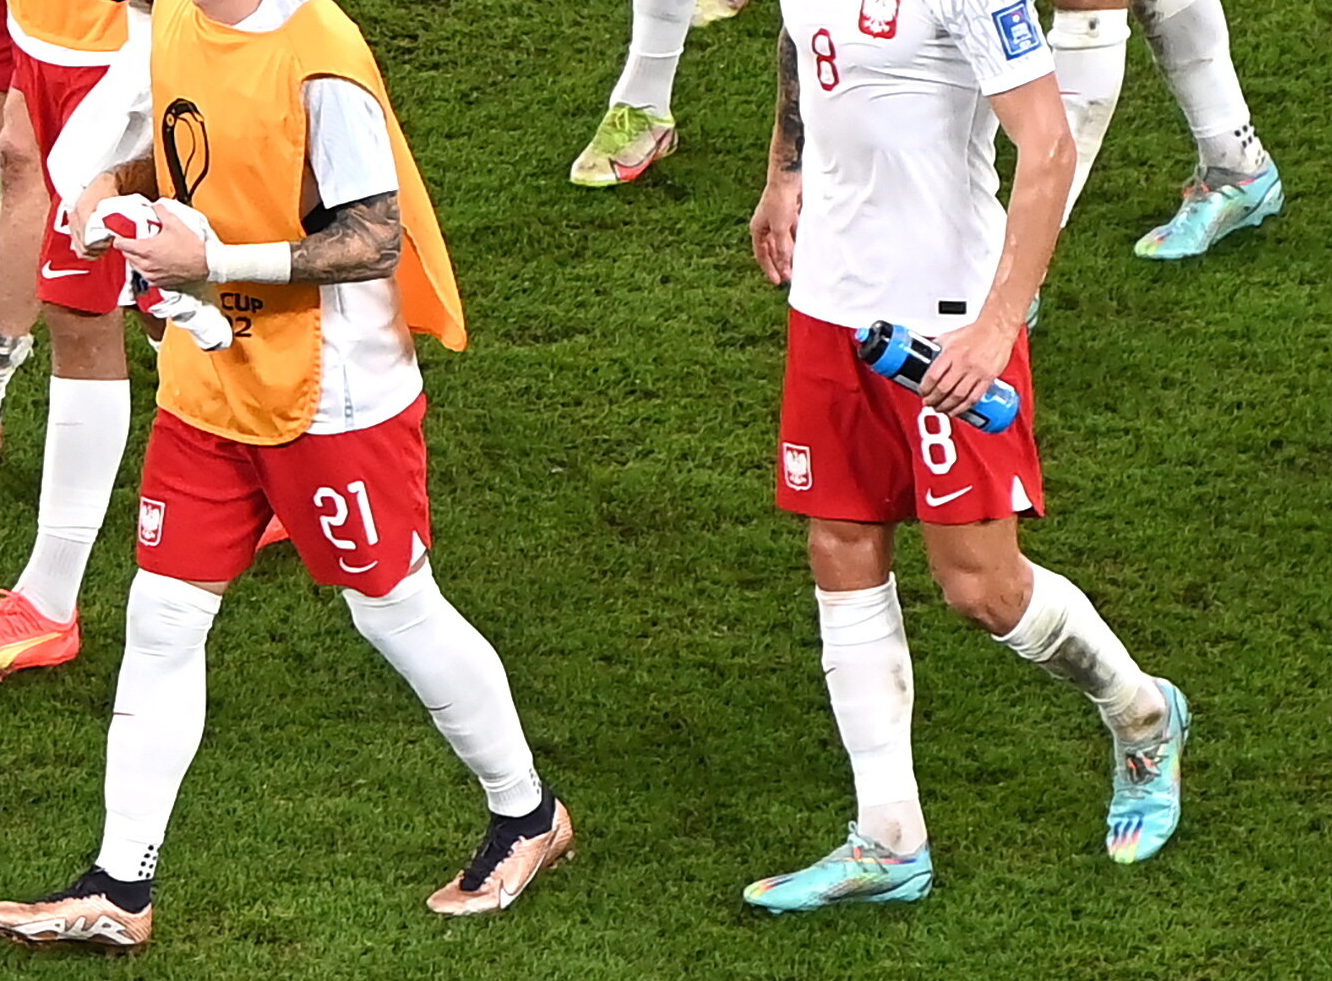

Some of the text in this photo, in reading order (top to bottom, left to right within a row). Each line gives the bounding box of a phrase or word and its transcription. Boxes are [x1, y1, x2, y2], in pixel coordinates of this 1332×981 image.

[811, 28, 840, 92] 8
[220, 292, 264, 313] CUP
[917, 406, 958, 475] 8
[313, 480, 379, 550] 21
